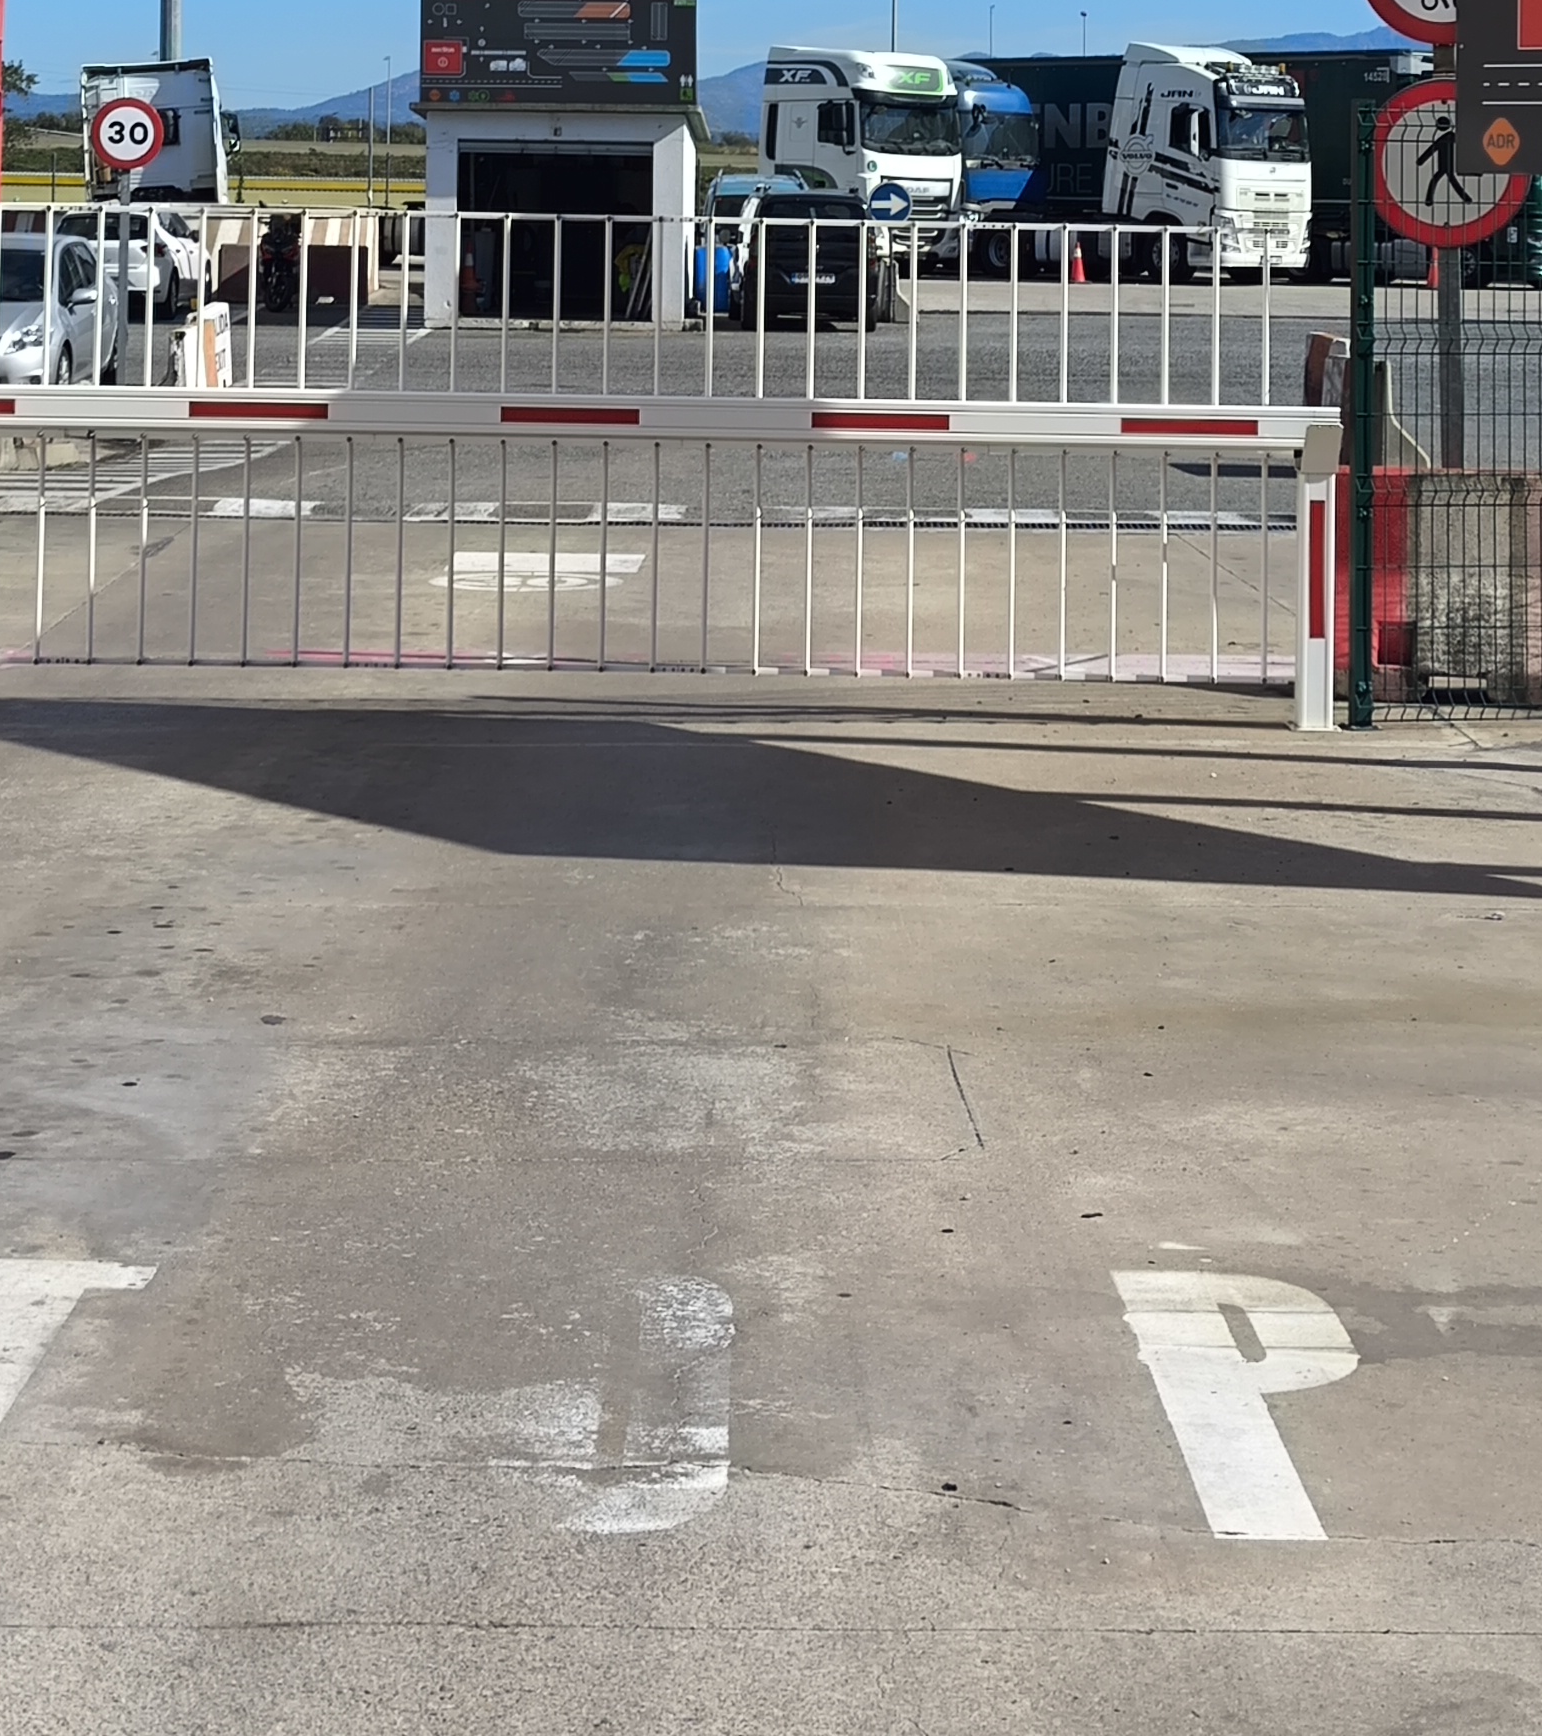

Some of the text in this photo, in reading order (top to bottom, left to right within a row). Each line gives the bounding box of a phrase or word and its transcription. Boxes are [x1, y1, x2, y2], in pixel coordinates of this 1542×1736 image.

[779, 69, 812, 82] XF
[899, 71, 931, 84] XF
[1160, 89, 1194, 98] JAN
[1031, 102, 1112, 149] NB
[107, 120, 149, 145] 30
[1486, 133, 1516, 149] ADR
[1122, 152, 1153, 160] VOLVO
